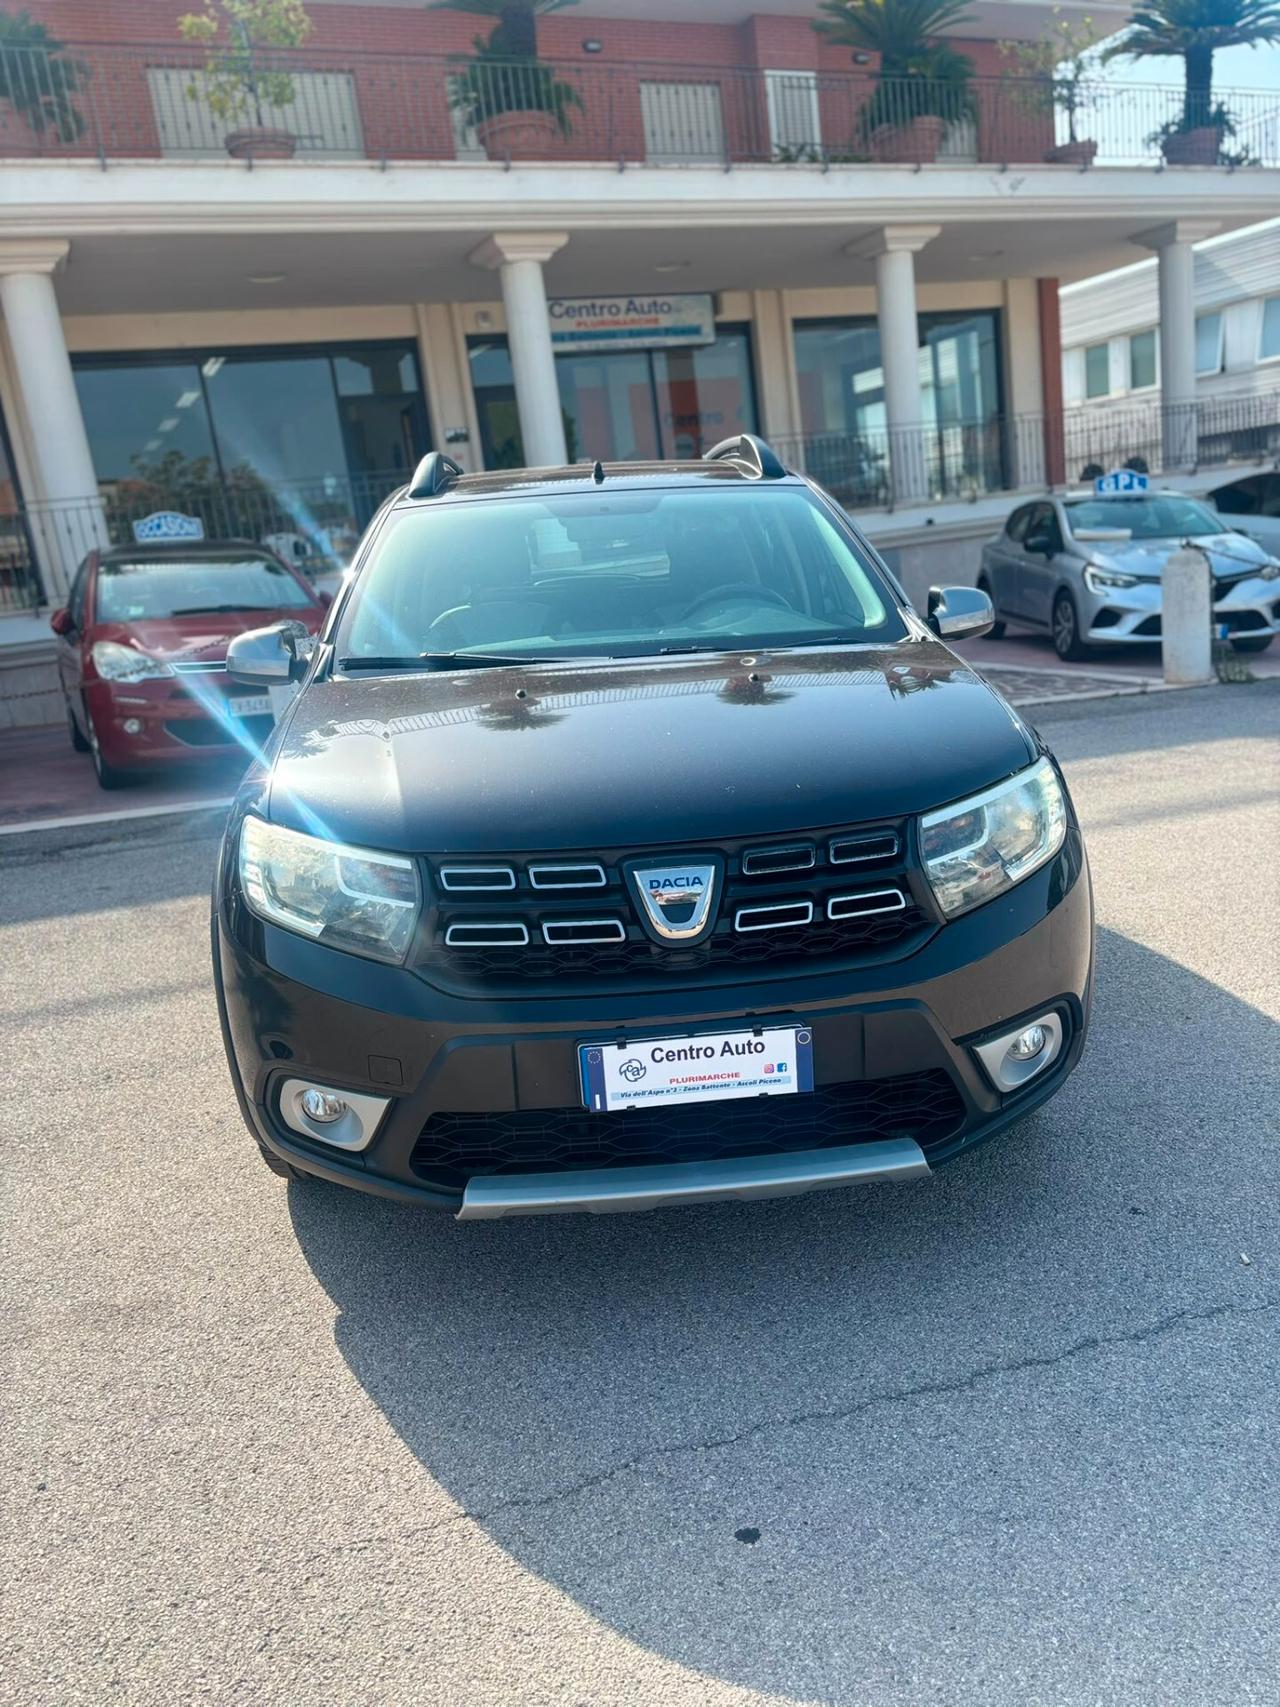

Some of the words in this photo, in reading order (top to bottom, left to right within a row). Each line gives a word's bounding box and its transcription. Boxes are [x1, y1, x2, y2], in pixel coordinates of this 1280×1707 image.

[548, 301, 620, 318] Centro
[624, 299, 672, 315] Auto
[1101, 473, 1144, 491] GPL
[649, 876, 703, 889] DACIA
[651, 1044, 715, 1064] Centro
[720, 1040, 766, 1058] Auto
[669, 1071, 741, 1084] PLURIMARCHE
